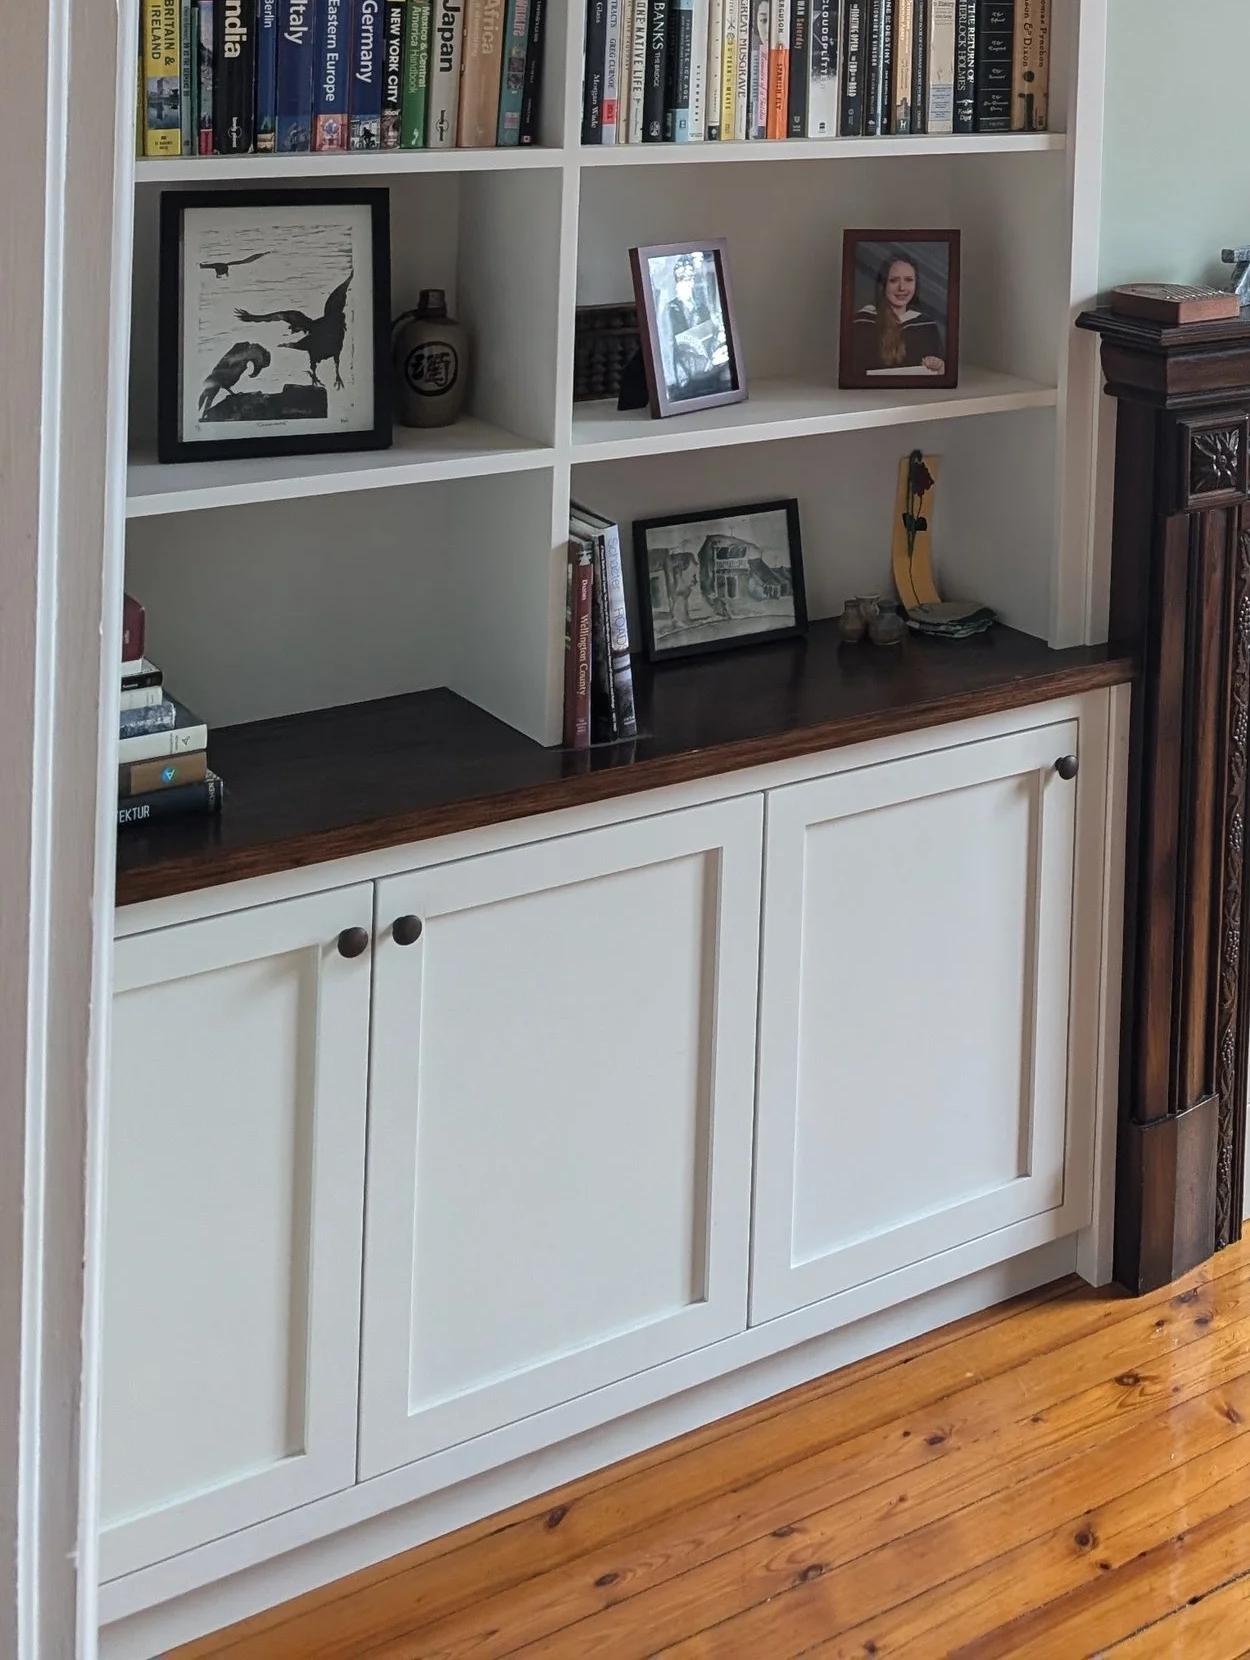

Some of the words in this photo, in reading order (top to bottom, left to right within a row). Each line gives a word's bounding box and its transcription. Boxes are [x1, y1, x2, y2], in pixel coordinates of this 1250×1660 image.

[164, 0, 174, 50] BRITAIN
[284, 0, 308, 44] Italy
[390, 8, 400, 36] NEW
[410, 6, 420, 47] America
[420, 6, 430, 40] Mexico
[636, 2, 646, 22] ONE
[652, 2, 665, 50] BANKS
[968, 3, 976, 24] THE
[151, 4, 161, 60] IRELAND
[356, 0, 378, 83] Germany
[608, 38, 617, 58] GREG
[634, 27, 645, 65] NATIVE
[794, 18, 804, 50] Saturday
[967, 27, 975, 66] RETURN
[1038, 27, 1047, 68] Pynchon
[164, 57, 174, 66] &
[388, 38, 400, 72] YORK
[738, 38, 747, 98] MUSGRAVE
[1022, 38, 1032, 67] Dixon
[323, 53, 339, 101] Europe
[408, 49, 418, 93] Handbook
[418, 53, 428, 88] Central
[608, 60, 616, 89] CURNOE
[633, 70, 643, 92] LIFE
[957, 51, 966, 91] HOLMES
[967, 69, 974, 83] OF
[387, 76, 398, 102] CITY
[591, 74, 600, 104] Morgan
[591, 107, 599, 128] Wade
[578, 614, 588, 661] Wellington
[578, 664, 588, 696] County
[119, 803, 150, 824] EKTUR
